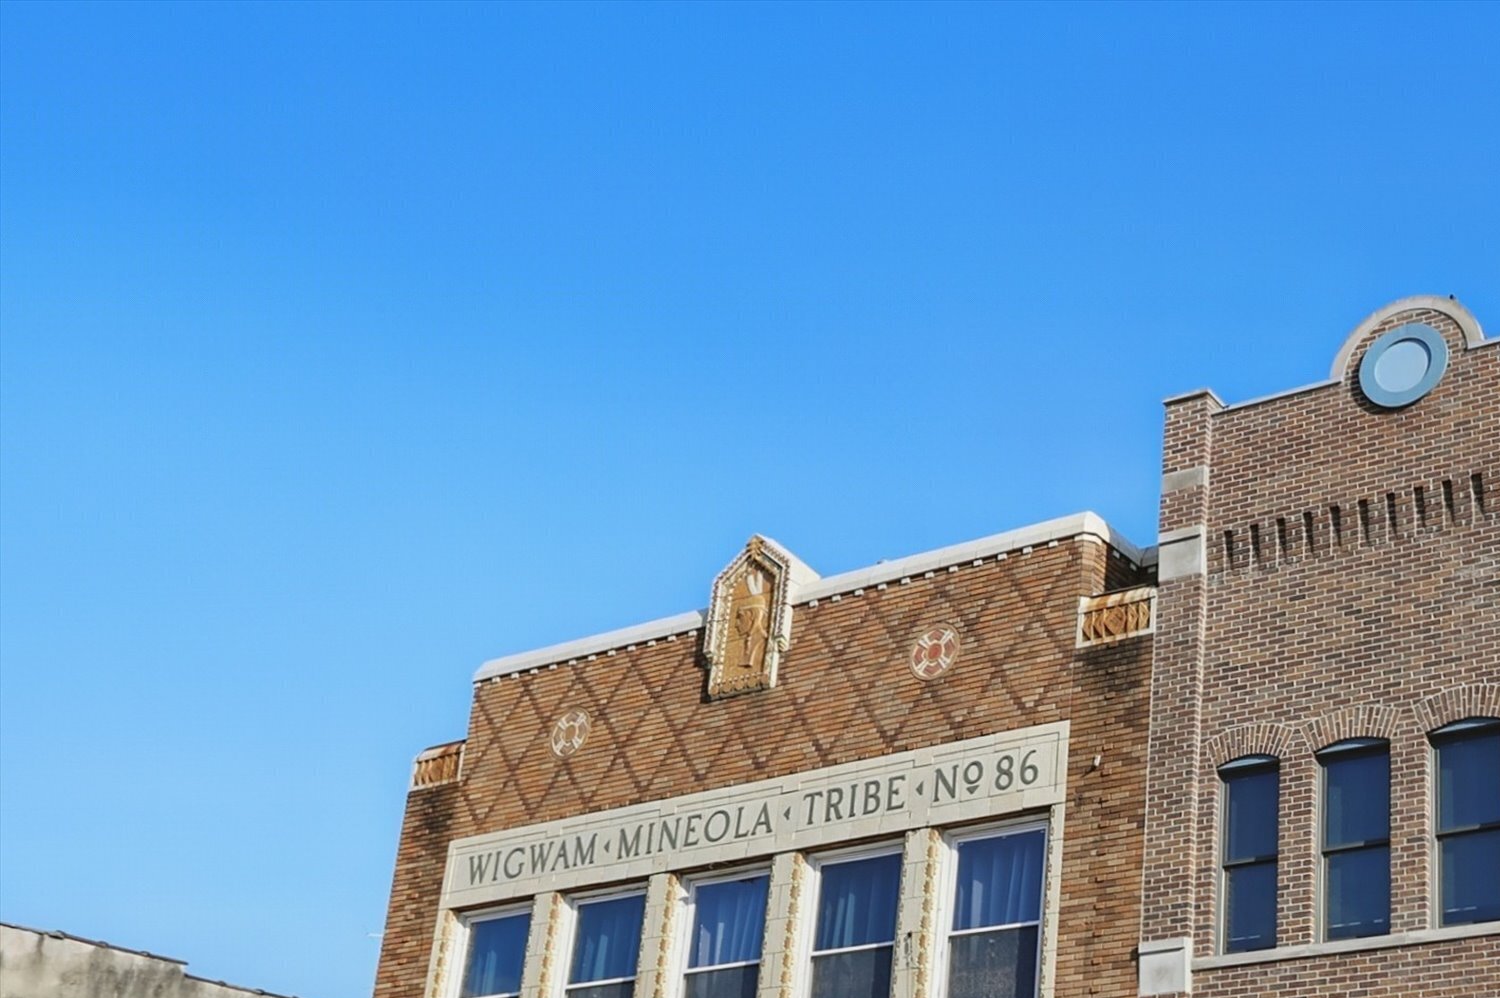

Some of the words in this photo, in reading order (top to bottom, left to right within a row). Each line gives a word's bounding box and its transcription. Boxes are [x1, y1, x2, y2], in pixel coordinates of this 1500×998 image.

[468, 833, 598, 886] WIGWAM
[616, 802, 774, 860] MINEOLA
[803, 774, 907, 825] TRIBE
[994, 749, 1039, 791] 86
